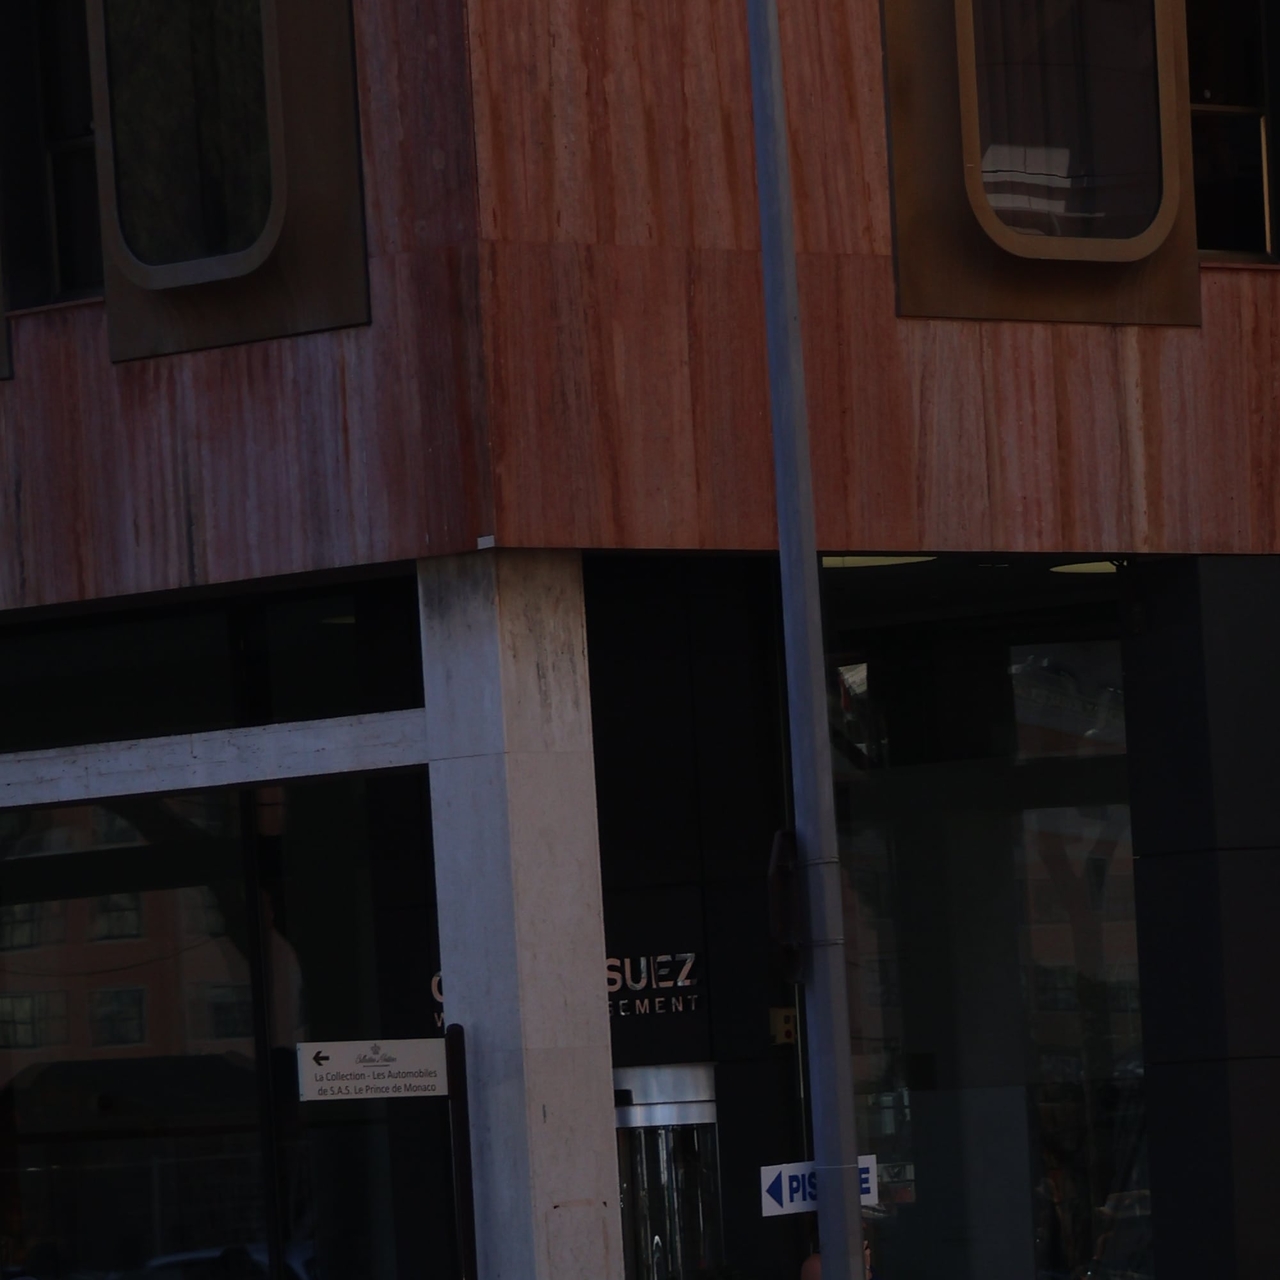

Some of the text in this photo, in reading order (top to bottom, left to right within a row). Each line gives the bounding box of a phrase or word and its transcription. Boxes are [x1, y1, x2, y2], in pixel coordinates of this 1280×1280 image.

[315, 1073, 324, 1082] La
[326, 1071, 366, 1082] Collection
[373, 1071, 386, 1080] Les
[388, 1069, 438, 1079] Automobiles
[318, 1083, 437, 1096] de S.A.S. Le Prince de Monaco
[788, 1166, 871, 1203] PISE
